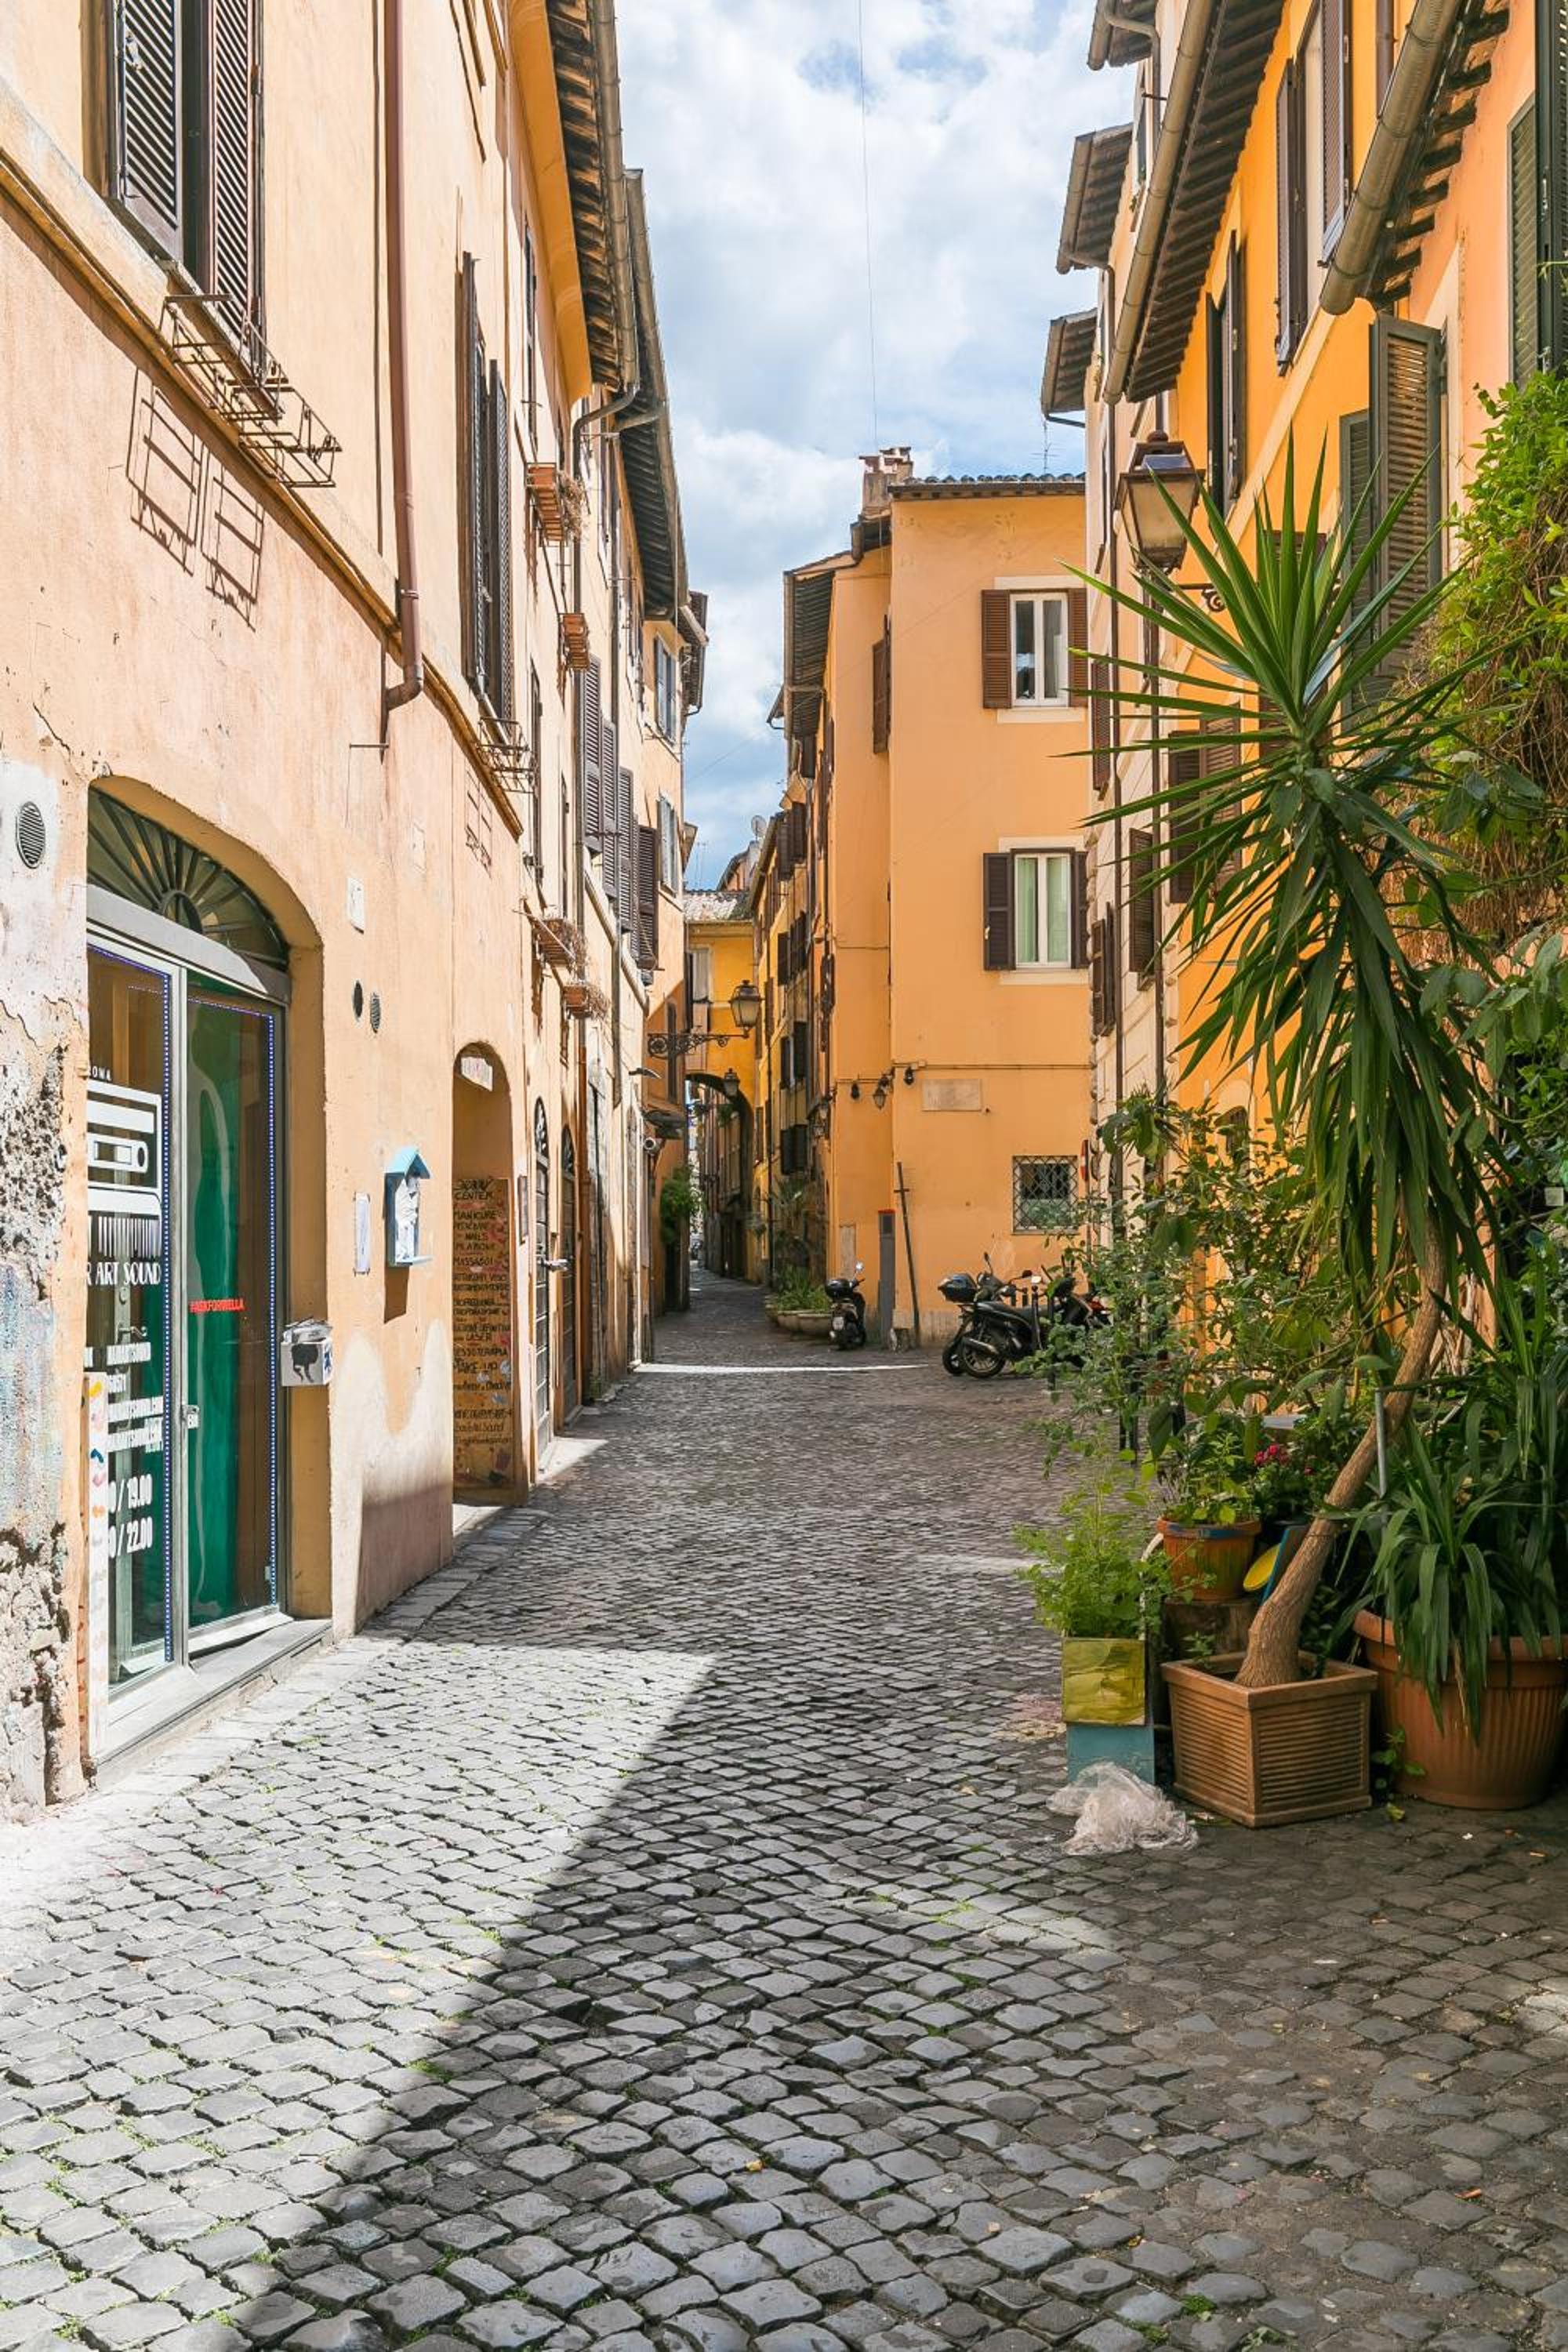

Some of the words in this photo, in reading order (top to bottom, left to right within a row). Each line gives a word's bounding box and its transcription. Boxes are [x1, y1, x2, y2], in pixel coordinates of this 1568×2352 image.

[95, 1261, 119, 1285] ART
[123, 1261, 162, 1285] SOUND
[127, 1474, 152, 1509] 19.00
[126, 1516, 153, 1553] 22.00
